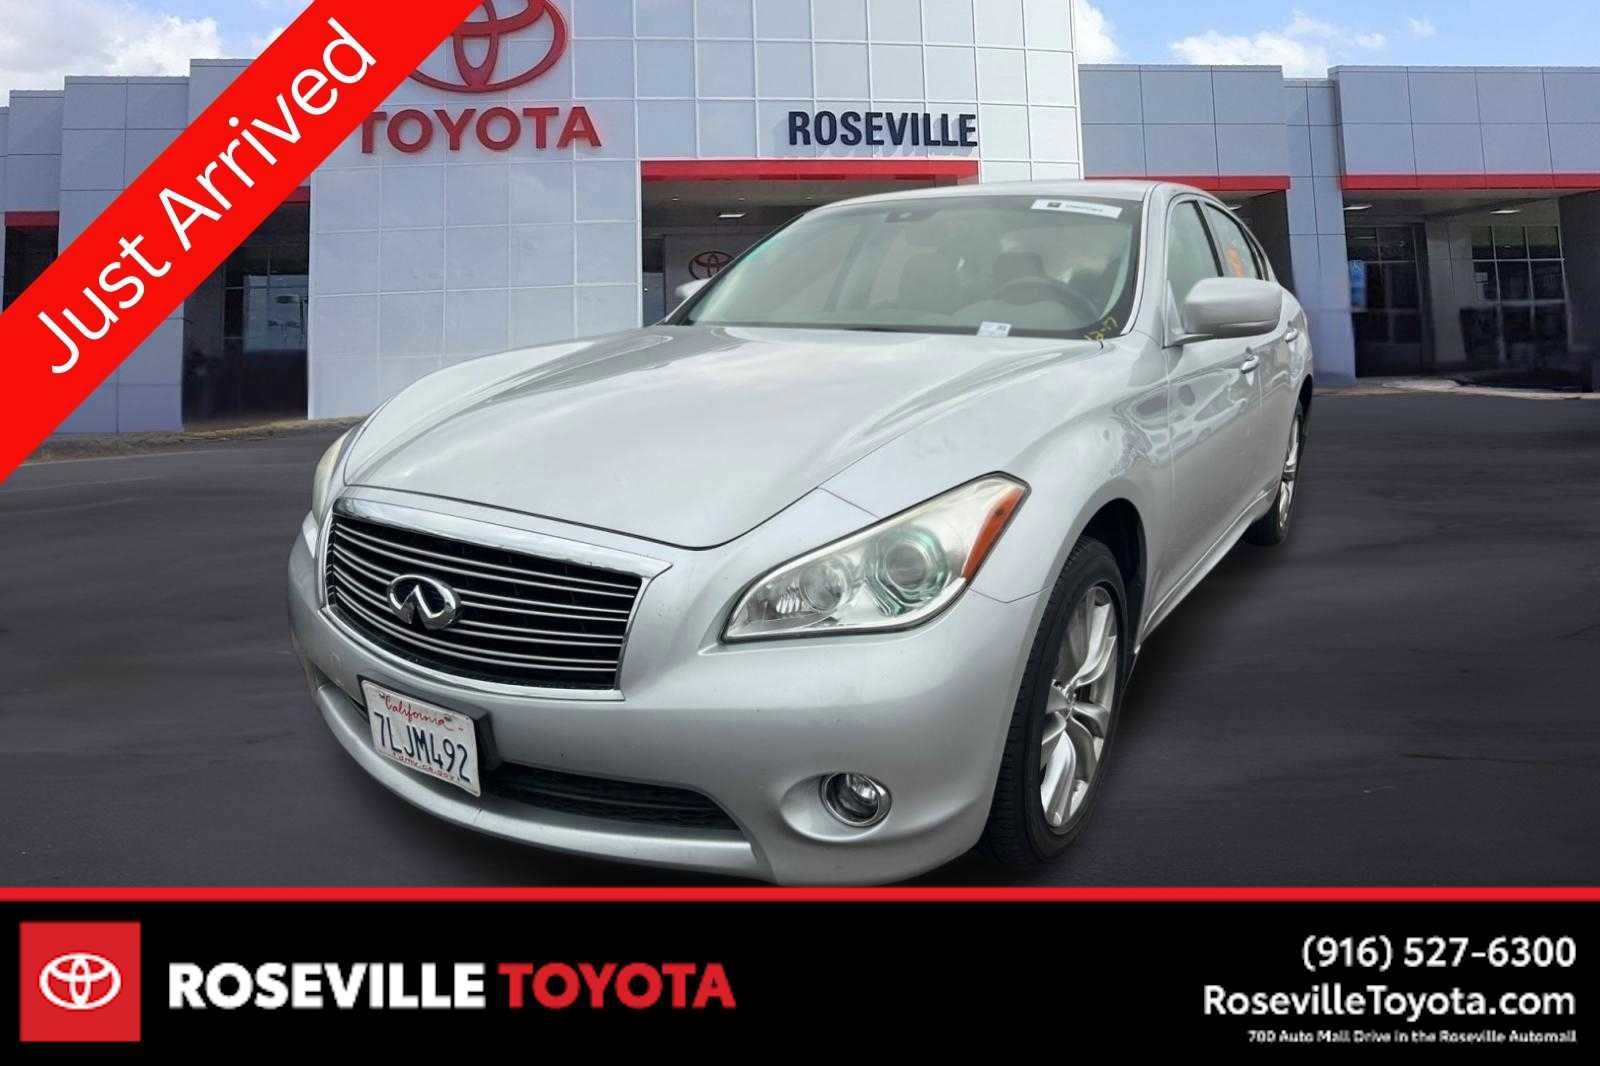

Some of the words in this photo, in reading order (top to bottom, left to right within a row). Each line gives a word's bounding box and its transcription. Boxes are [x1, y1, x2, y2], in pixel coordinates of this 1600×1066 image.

[361, 106, 602, 154] TOYOTA
[788, 110, 978, 147] ROSEVILLE
[384, 694, 454, 731] California
[374, 711, 470, 782] 7LJM492
